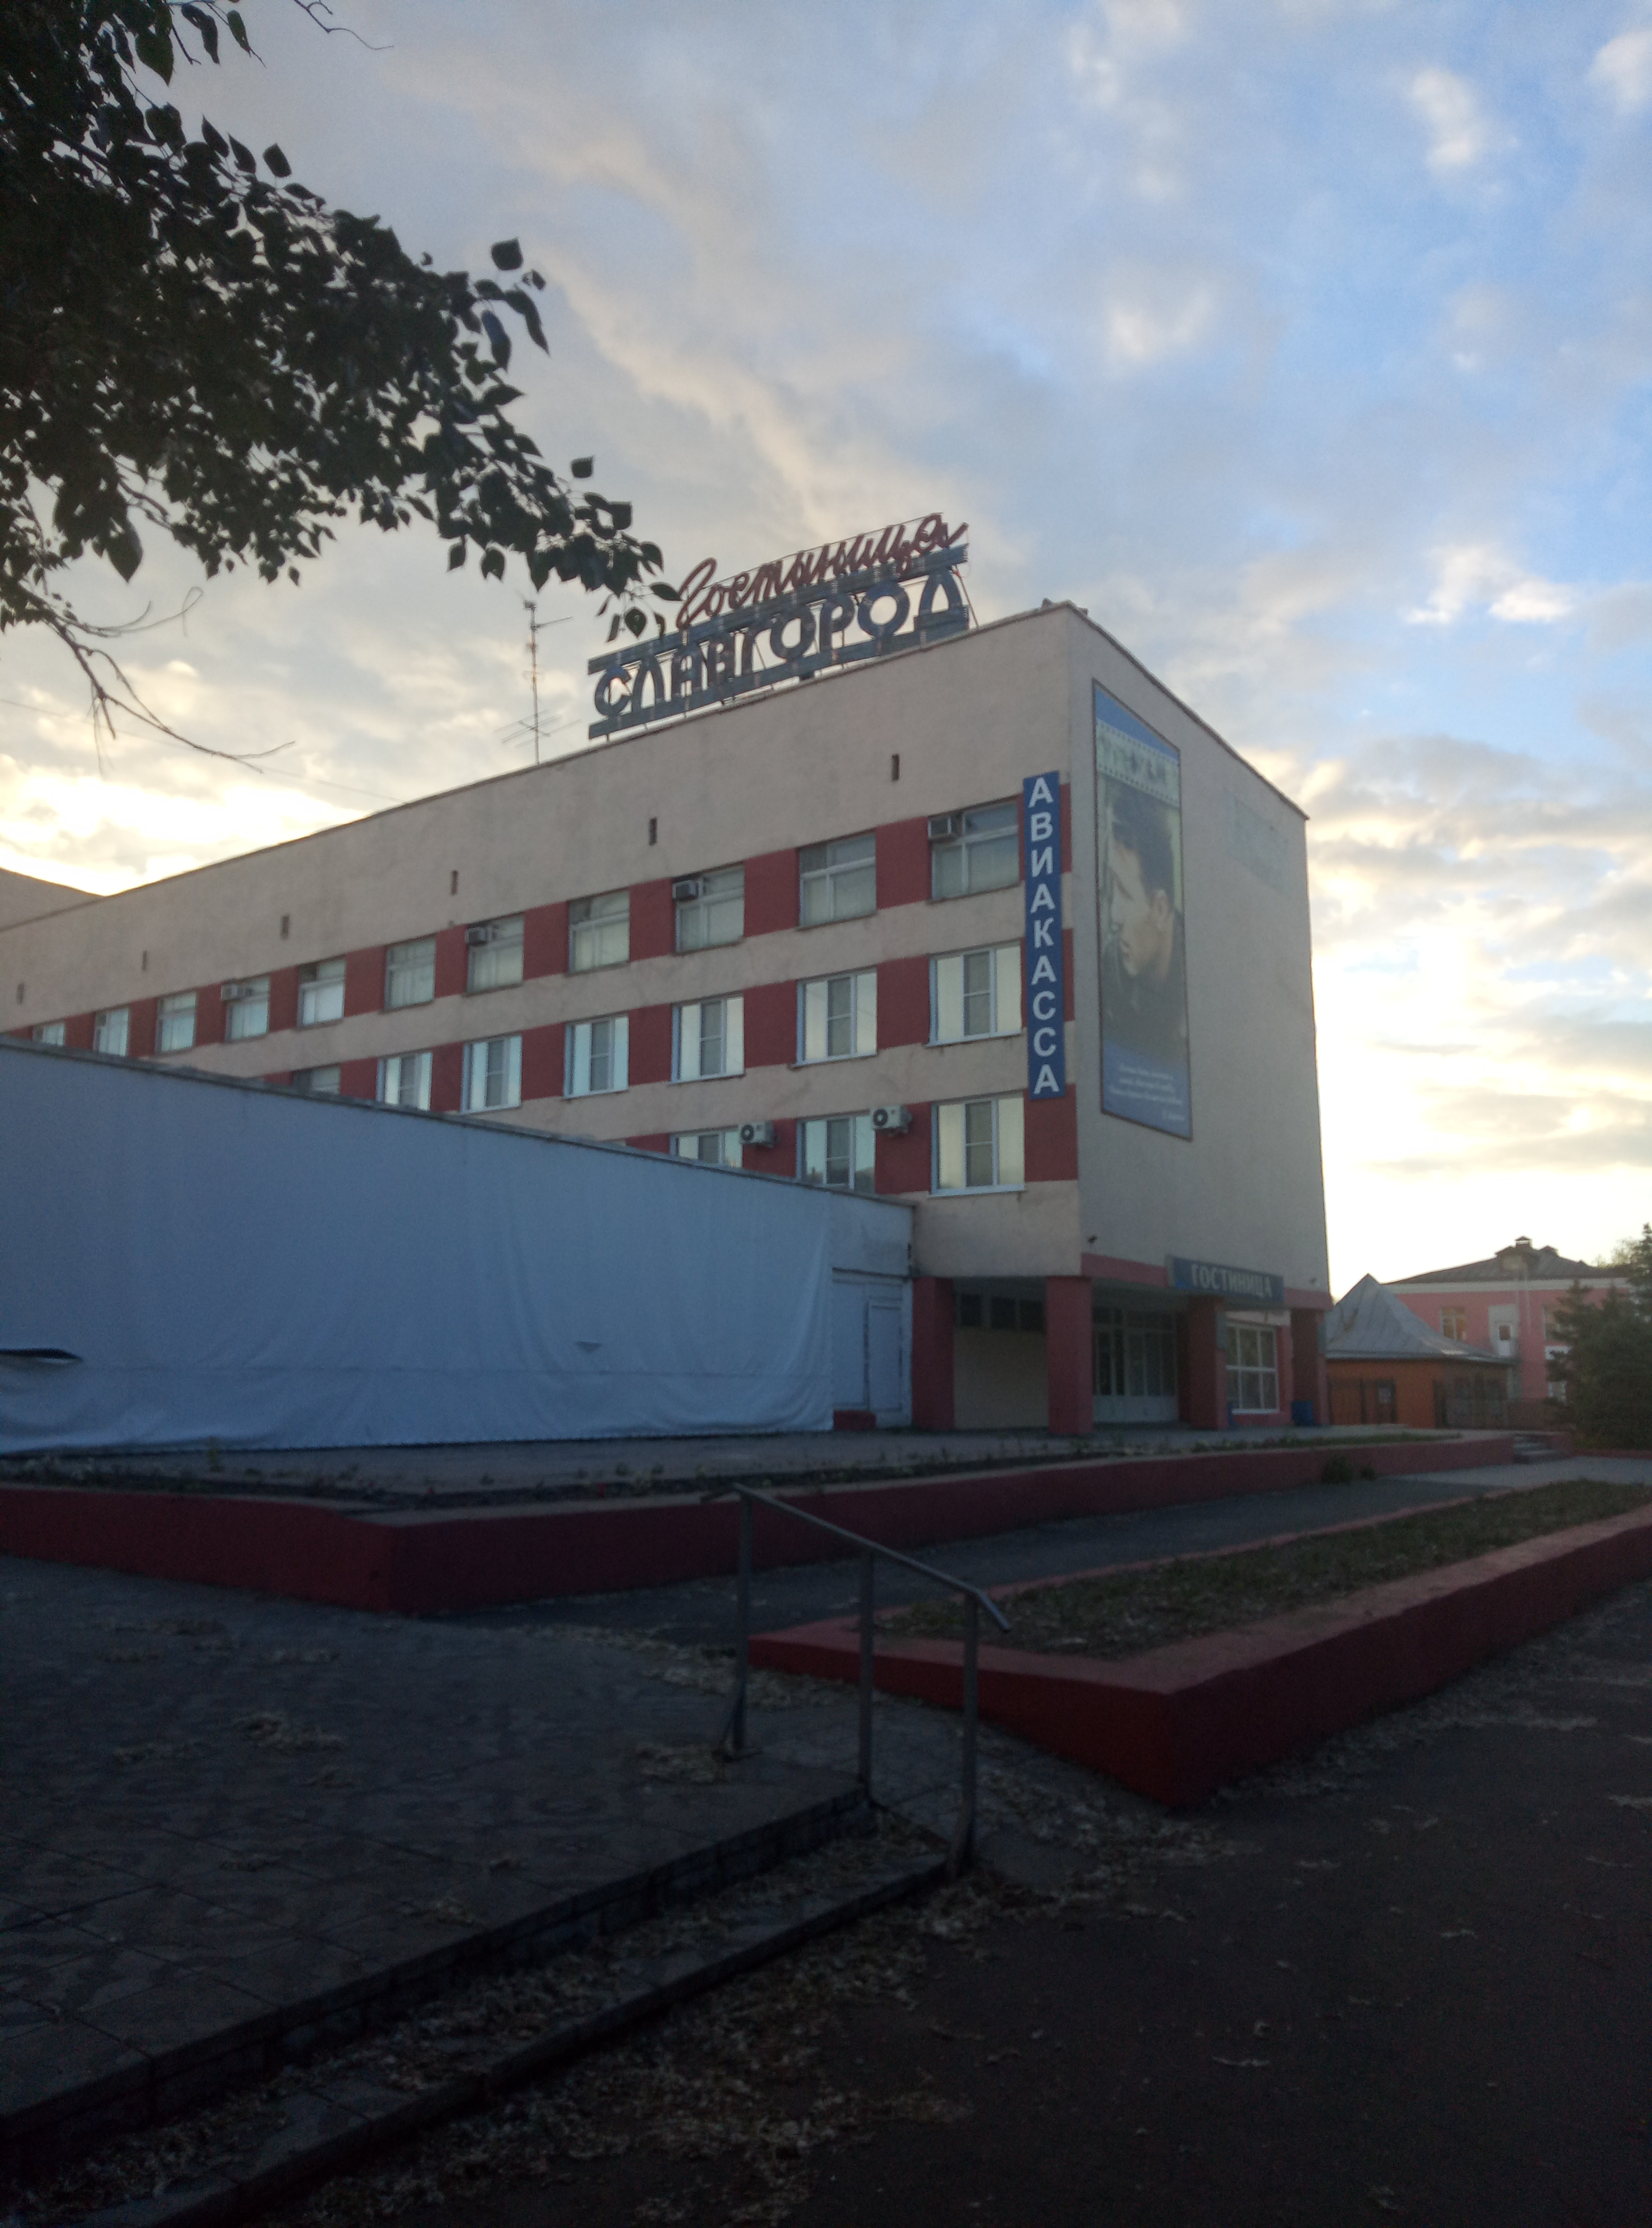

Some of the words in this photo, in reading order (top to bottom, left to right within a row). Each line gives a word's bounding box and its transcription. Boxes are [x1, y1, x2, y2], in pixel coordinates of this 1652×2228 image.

[594, 567, 969, 717] СЛАВГОРОД
[676, 511, 968, 630] Гостиница
[1028, 777, 1059, 1094] АВИАКАССА
